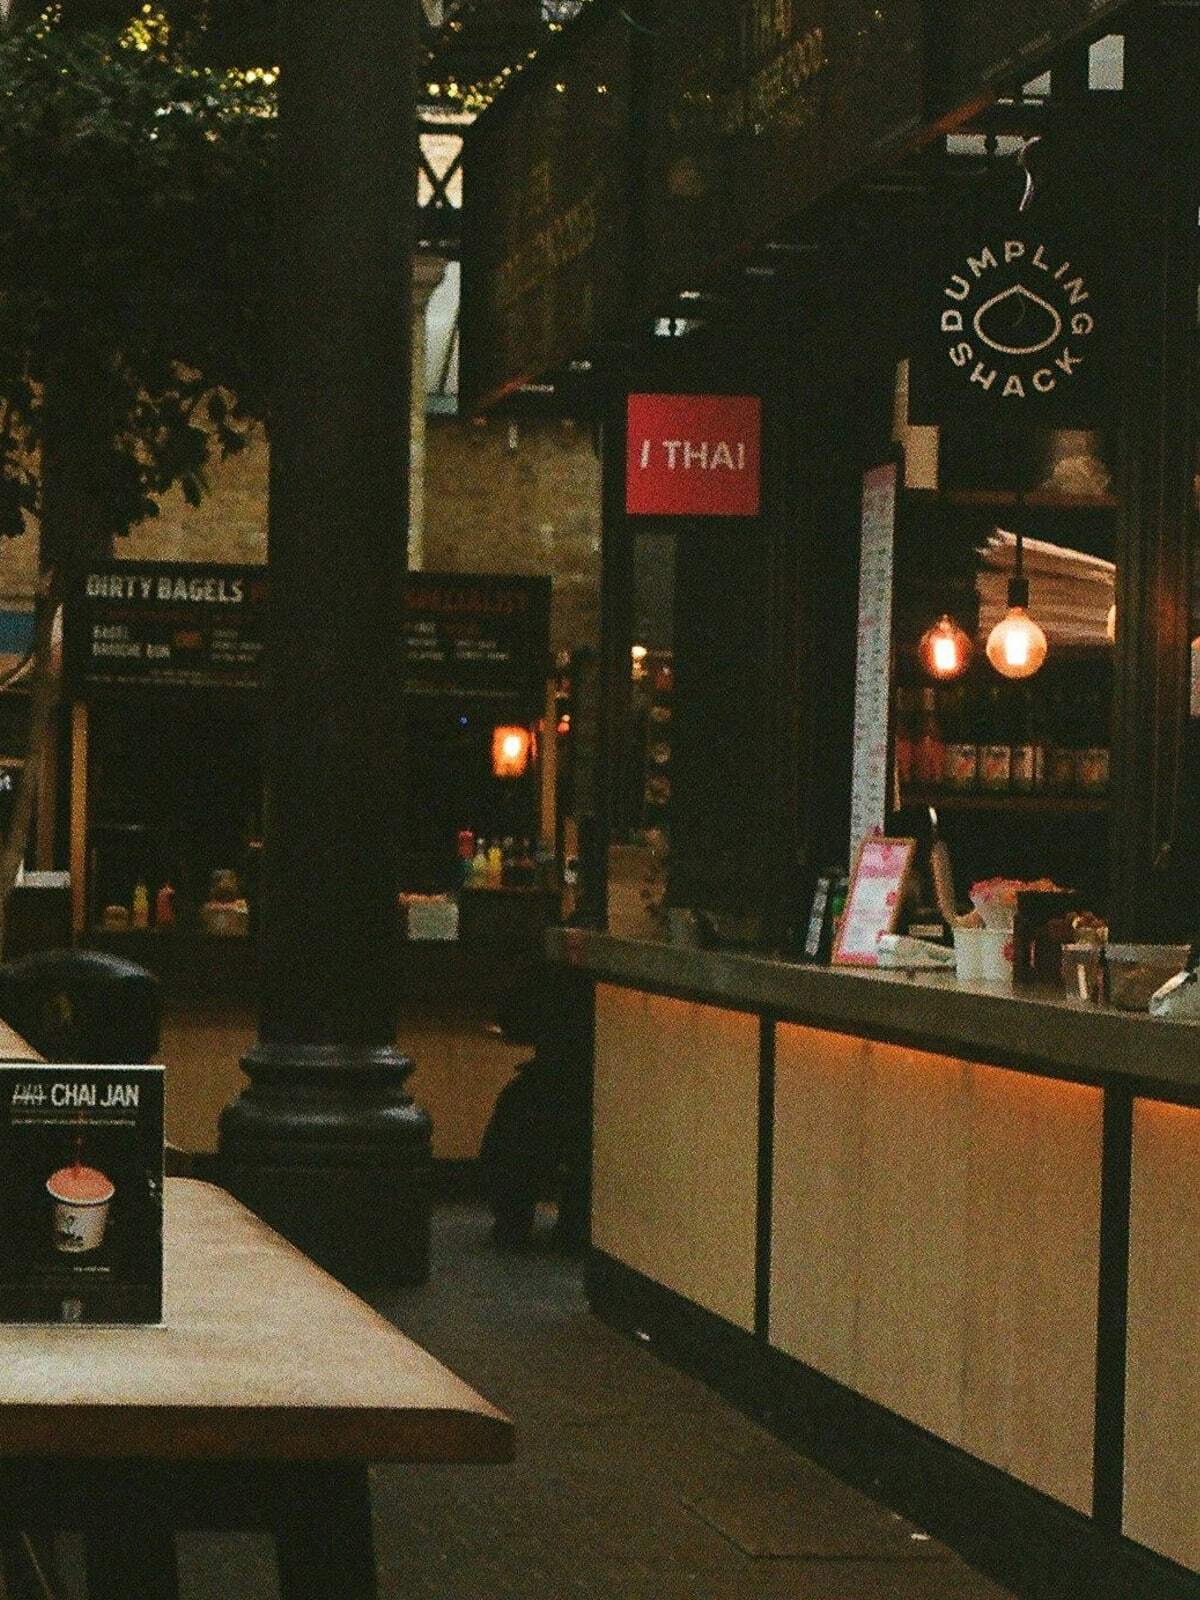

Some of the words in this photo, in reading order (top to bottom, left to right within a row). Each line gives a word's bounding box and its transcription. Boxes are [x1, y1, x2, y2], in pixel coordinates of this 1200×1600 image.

[940, 240, 1095, 336] DUMPLING
[948, 341, 1084, 399] SHACK
[662, 439, 746, 471] THAI
[86, 574, 151, 599] DIRTY
[156, 576, 244, 603] BAGELS
[51, 1083, 97, 1107] CHAI
[101, 1083, 140, 1107] JAN
